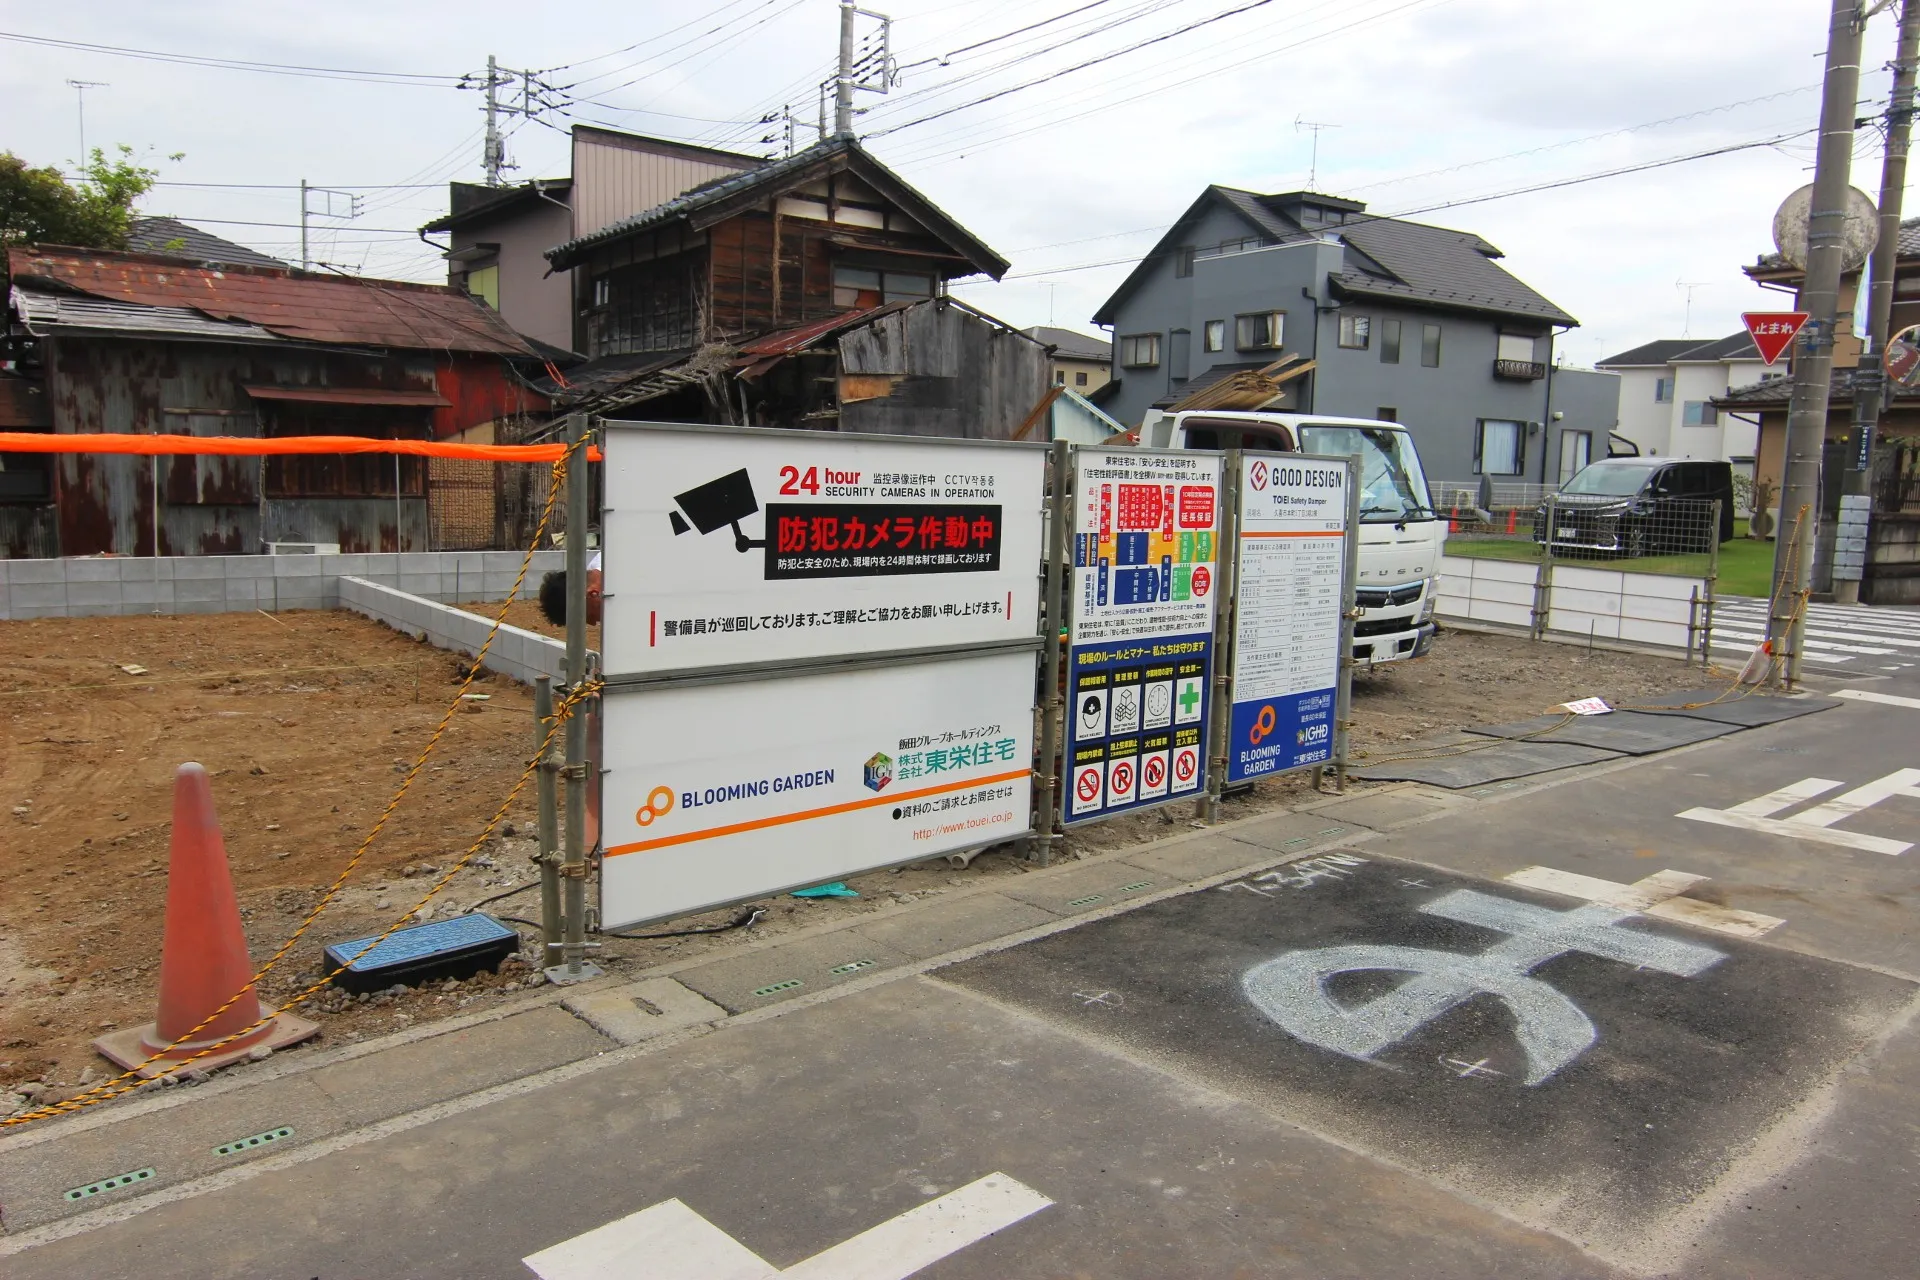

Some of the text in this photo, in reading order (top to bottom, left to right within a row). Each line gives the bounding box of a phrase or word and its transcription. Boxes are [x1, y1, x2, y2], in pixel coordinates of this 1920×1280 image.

[1753, 322, 1794, 335] 止まれ
[779, 465, 861, 496] 24 hour
[1272, 467, 1342, 488] GOOD DESIGN
[825, 486, 995, 498] SECURITY CAMERAS IN OPERATION
[1290, 497, 1307, 506] Safety
[1308, 497, 1327, 505] Damper
[778, 514, 994, 552] 防犯カメラ作動中
[778, 552, 992, 571] 防犯と安全のため、現場内を24時間体制で録画しております
[1360, 566, 1424, 577] FUSO
[663, 600, 1003, 637] 警備員が巡回しております。ご理解とご協力をお願い申し上げます。
[1078, 641, 1205, 665] 現場のルールとマナー 私たちは守ります
[1179, 664, 1202, 674] 安全第一
[899, 725, 1001, 750] 飯田グループホールディングス
[1176, 736, 1198, 746] 立入禁止
[925, 738, 1016, 774] 東栄住宅
[1240, 744, 1281, 763] BLOOMING
[1244, 758, 1276, 776] GARDEN
[682, 769, 835, 809] BLOOMING GARDEN
[912, 810, 1013, 841] http://www.touei.co.jp
